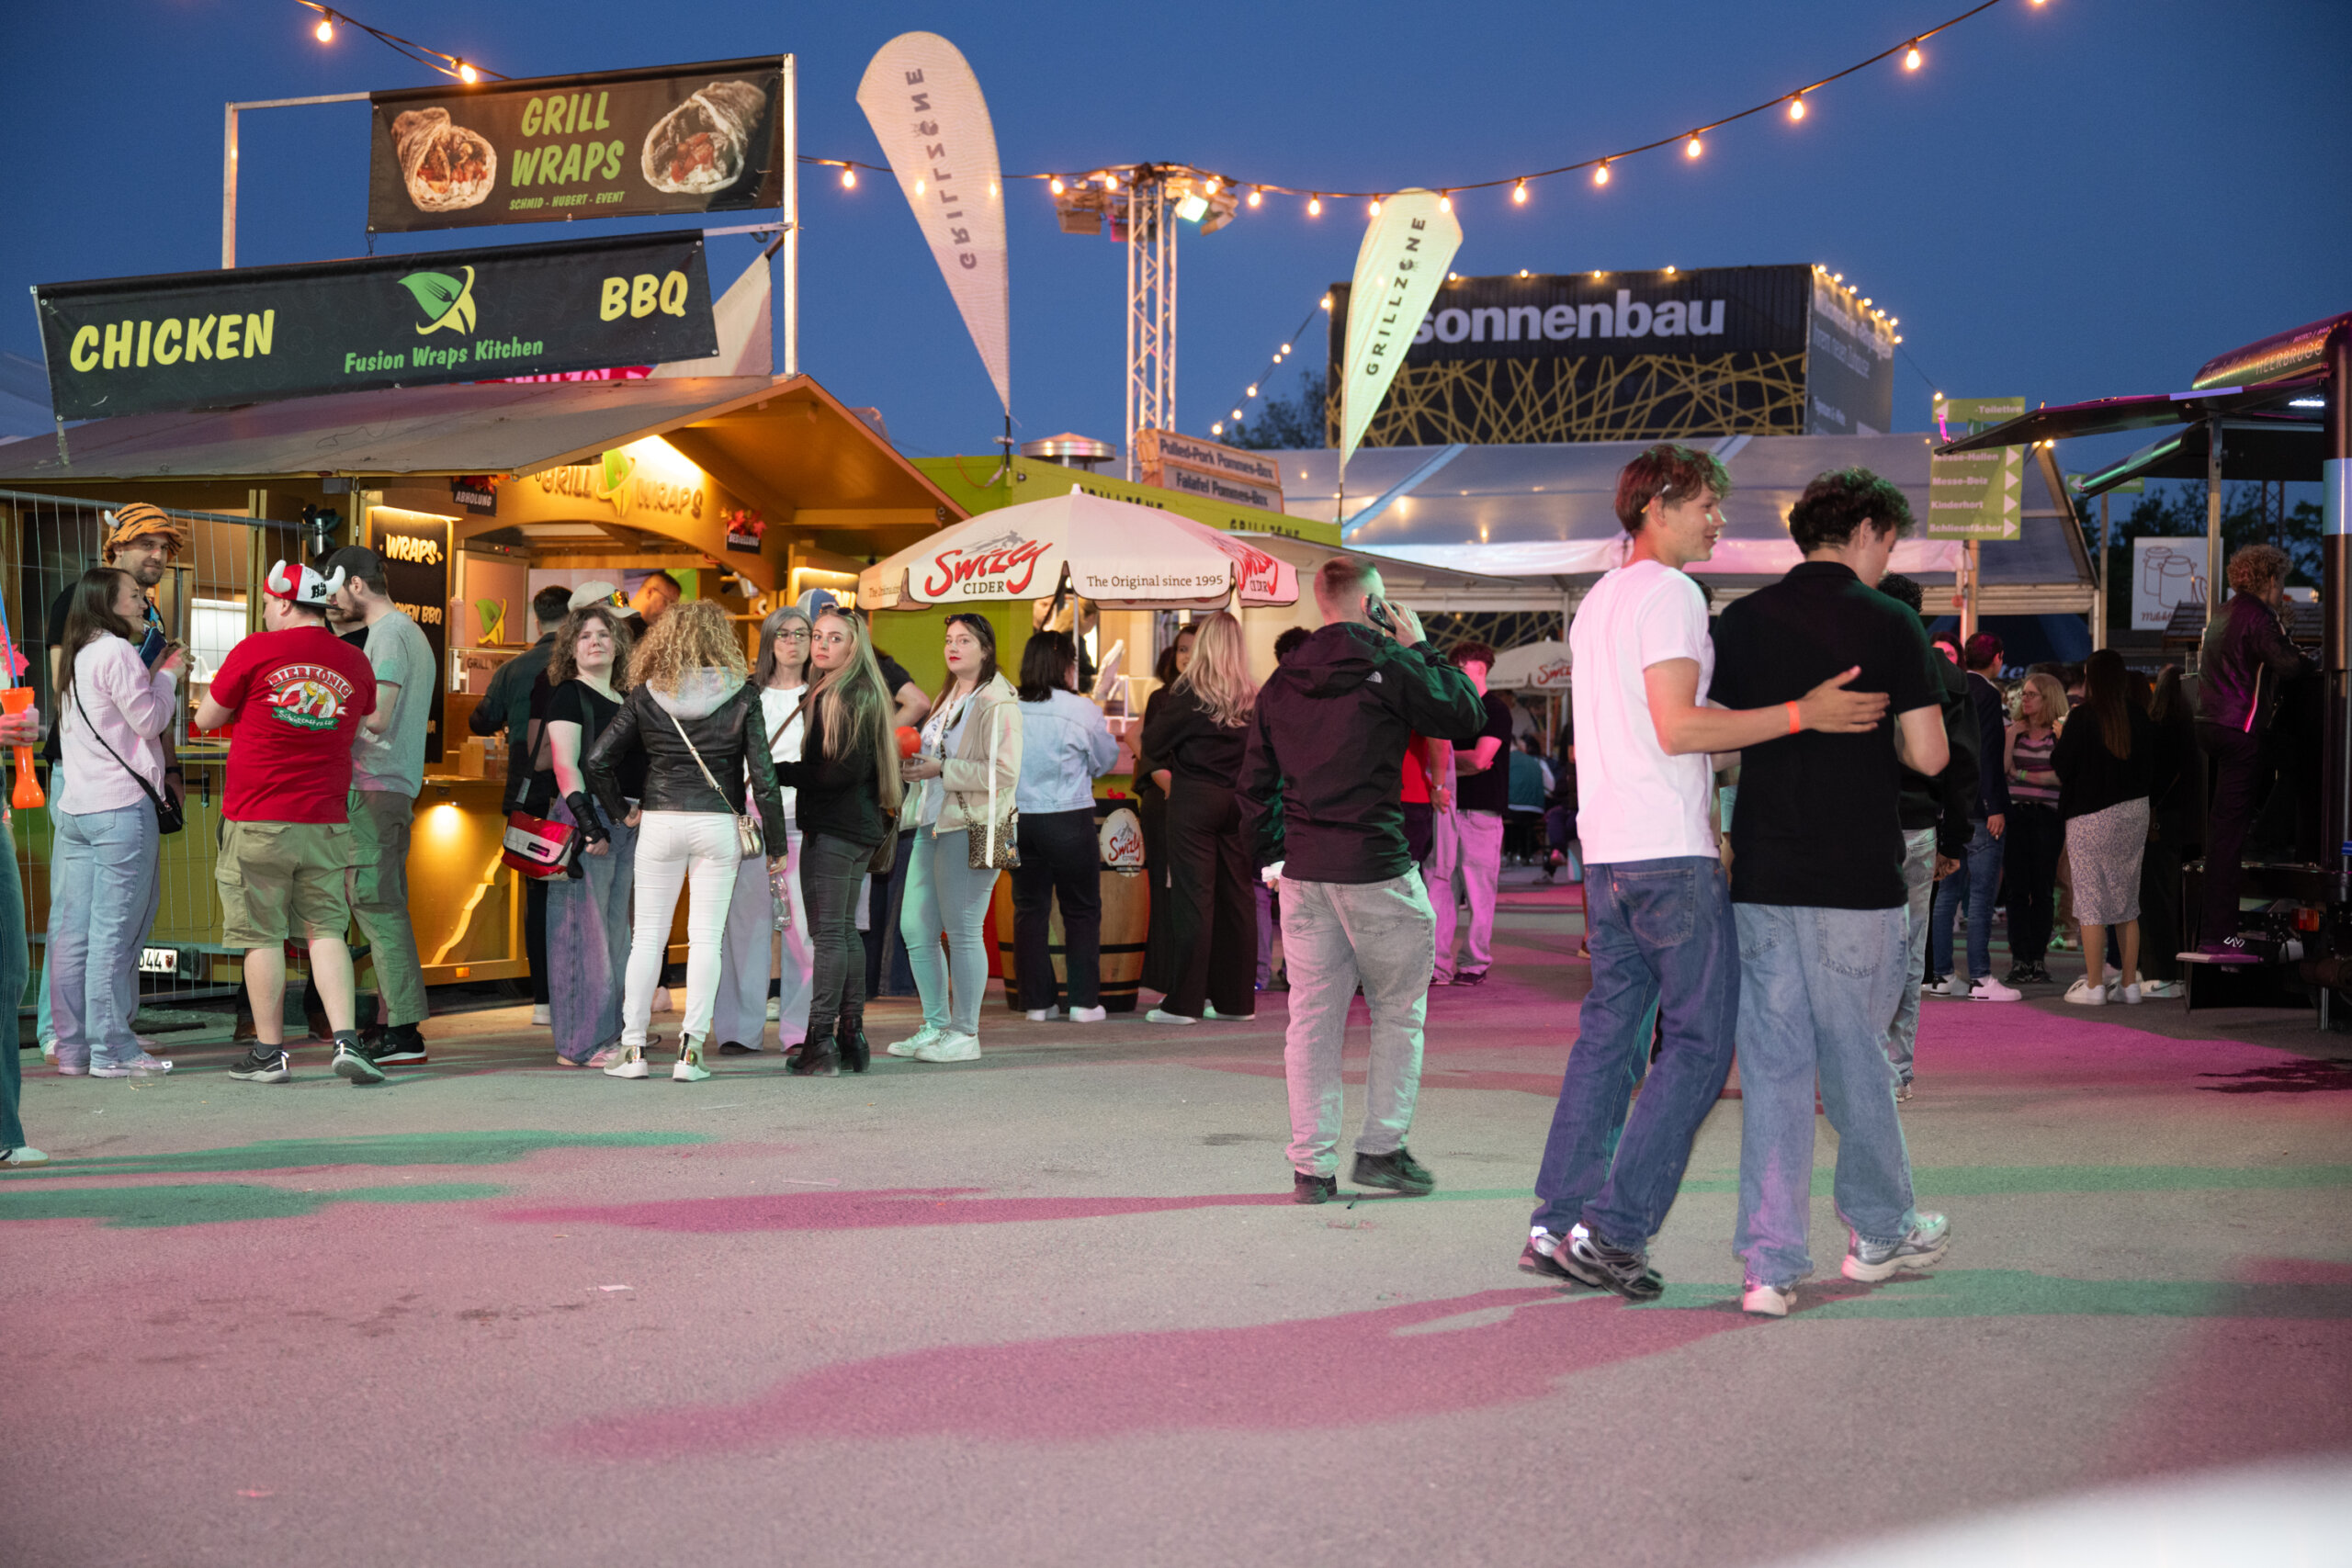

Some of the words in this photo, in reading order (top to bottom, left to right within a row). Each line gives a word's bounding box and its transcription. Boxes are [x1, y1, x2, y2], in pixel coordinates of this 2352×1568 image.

[521, 91, 610, 137] GRILL
[511, 140, 626, 187] WRAPS
[509, 197, 544, 210] SCHMID
[551, 194, 588, 208] HUBERT
[595, 191, 626, 204] EVENT
[600, 270, 689, 321] BBQ
[1411, 288, 1726, 344] sonnenbau
[70, 309, 275, 373] CHICKEN
[345, 350, 404, 374] Fusion
[413, 345, 468, 370] Wraps
[475, 336, 543, 361] Kitchen
[455, 491, 492, 506] ABHOLUNG
[541, 466, 592, 500] GRILL
[637, 478, 703, 520] WRAPS
[1931, 500, 1984, 509] Kinderhort
[385, 534, 438, 565] WRAPS
[924, 540, 1054, 597] Swizly
[1086, 575, 1108, 587] The
[1111, 575, 1159, 591] Original
[1162, 574, 1193, 587] since
[1195, 574, 1224, 586] 1995
[963, 581, 1005, 595] CIDER
[422, 605, 442, 626] BBQ
[269, 667, 352, 696] BIERKÖNIG
[1109, 832, 1140, 862] Swizly
